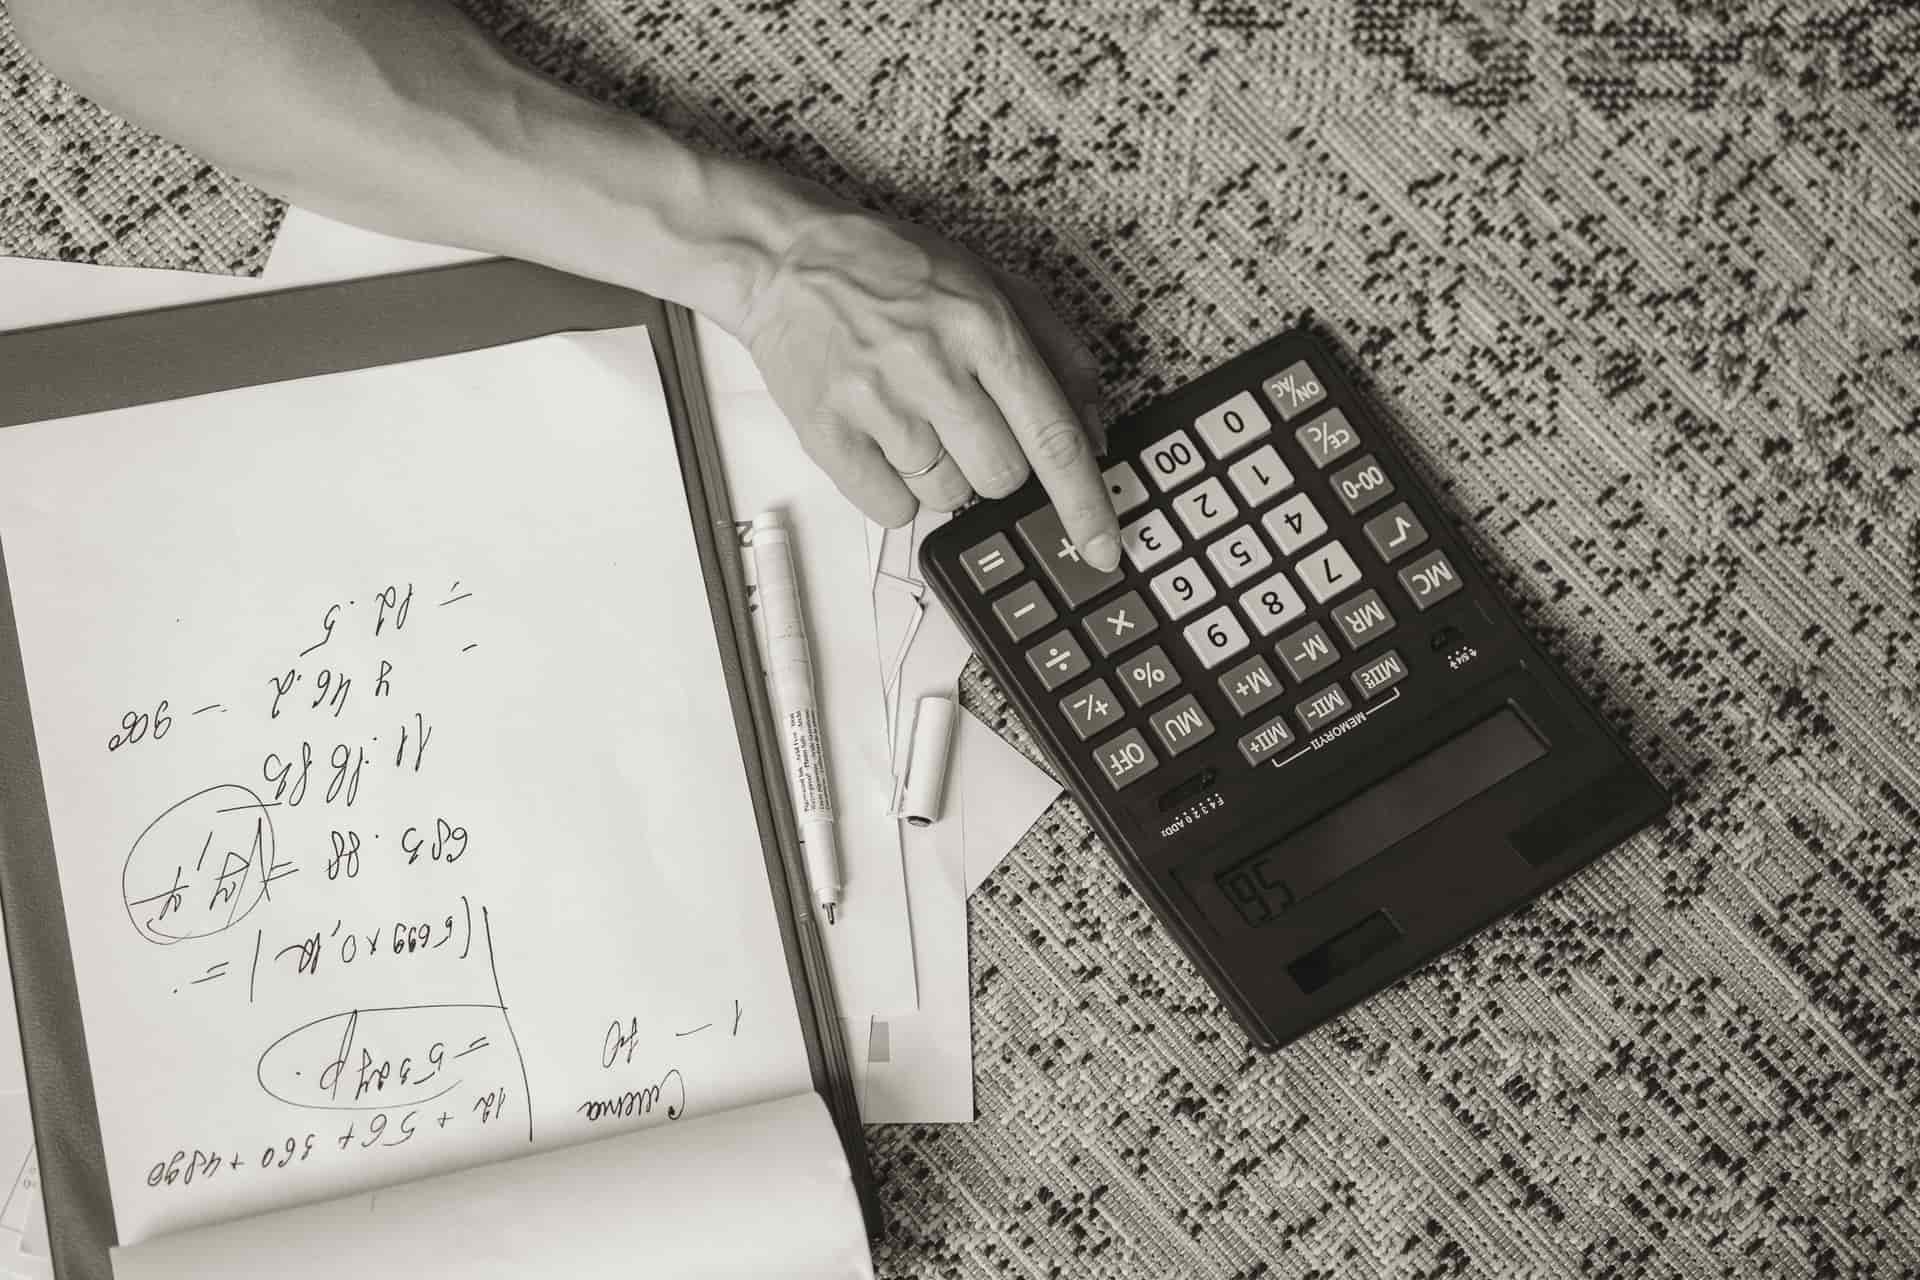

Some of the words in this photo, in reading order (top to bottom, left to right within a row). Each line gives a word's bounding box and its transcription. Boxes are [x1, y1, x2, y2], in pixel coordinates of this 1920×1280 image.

[1271, 375, 1320, 407] ON/AC
[1222, 410, 1245, 434] 0
[1154, 442, 1192, 475] 00
[1250, 464, 1271, 486] 1
[1192, 493, 1218, 519] 2
[1283, 511, 1304, 536] 4
[1138, 526, 1162, 552] 3
[1228, 541, 1253, 567] 5
[1322, 557, 1343, 585] 7
[1411, 560, 1453, 595] MC
[1171, 575, 1194, 601] 6
[1260, 591, 1285, 616] 8
[1344, 600, 1386, 634] MR
[1206, 622, 1229, 648] 9
[1234, 667, 1274, 697] M+
[1164, 706, 1204, 742] MU
[1109, 742, 1146, 777] OFF
